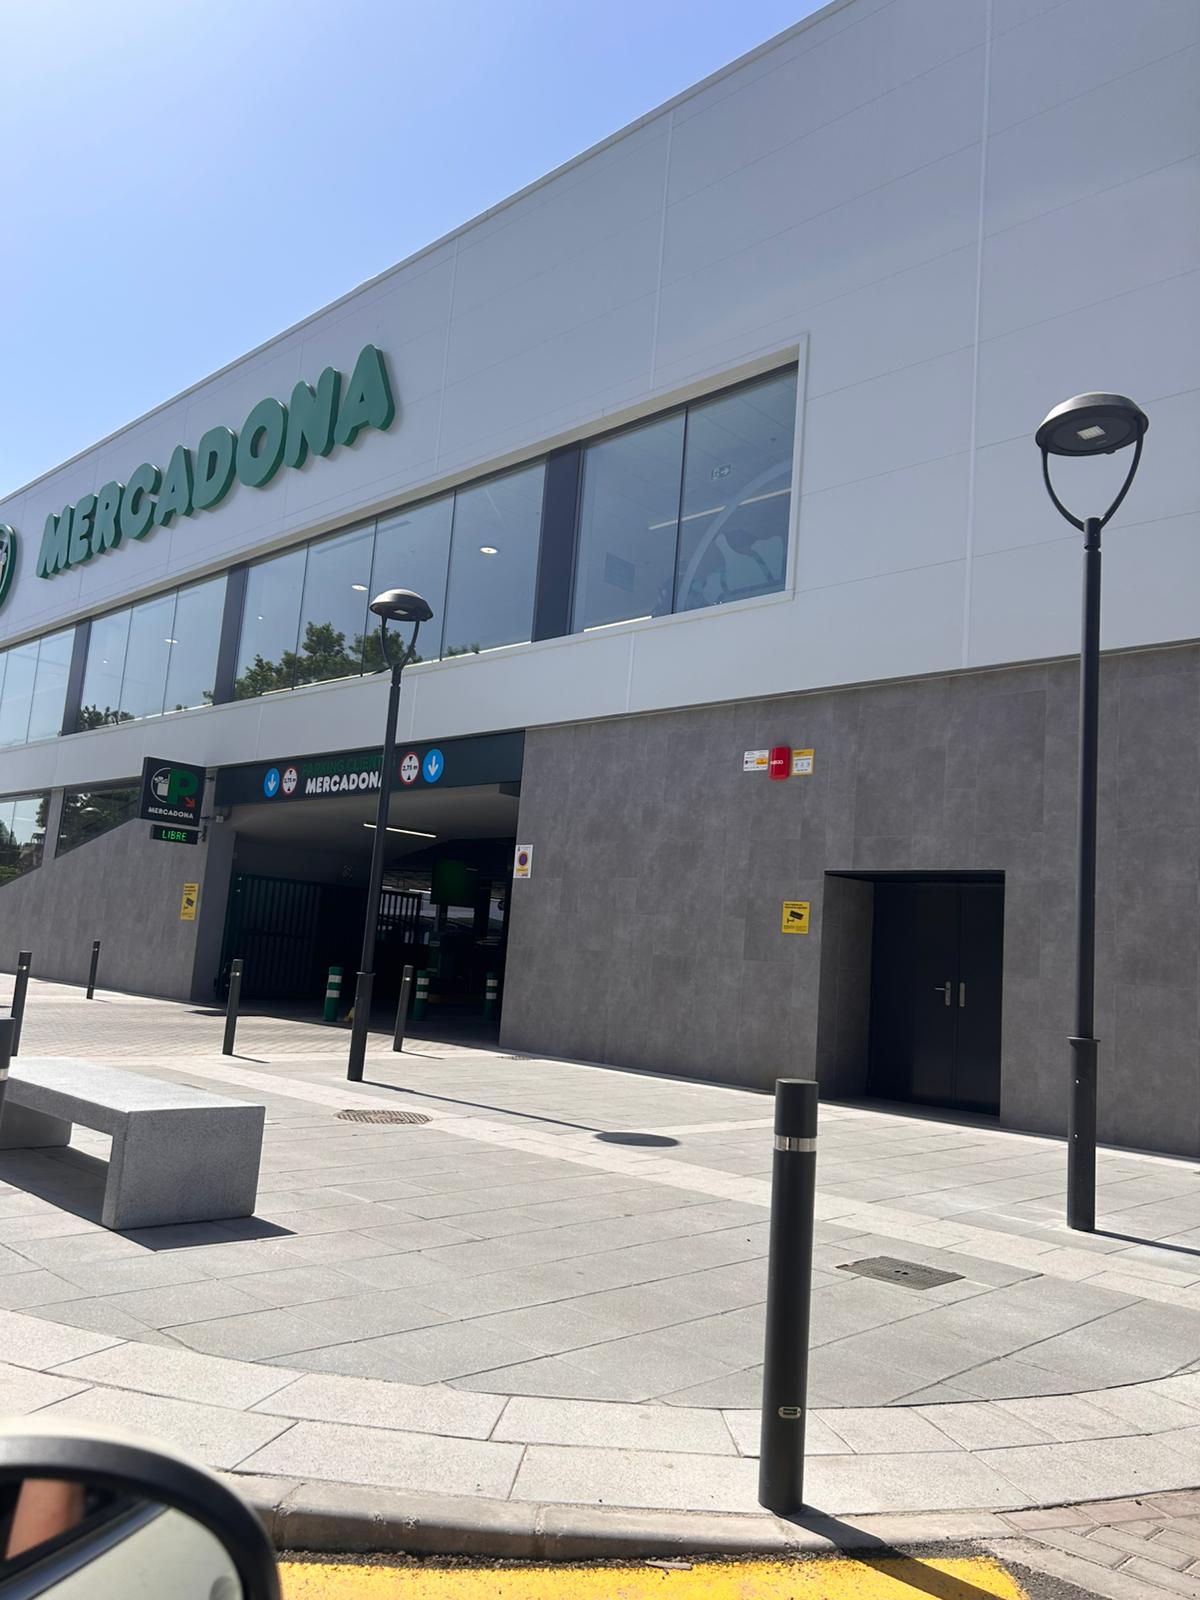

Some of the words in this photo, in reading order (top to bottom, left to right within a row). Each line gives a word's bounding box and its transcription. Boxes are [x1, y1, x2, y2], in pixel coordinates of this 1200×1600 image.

[36, 343, 395, 578] MERCADONA
[166, 768, 199, 805] P
[147, 806, 194, 820] MERCADONA
[162, 829, 188, 841] LIBRE
